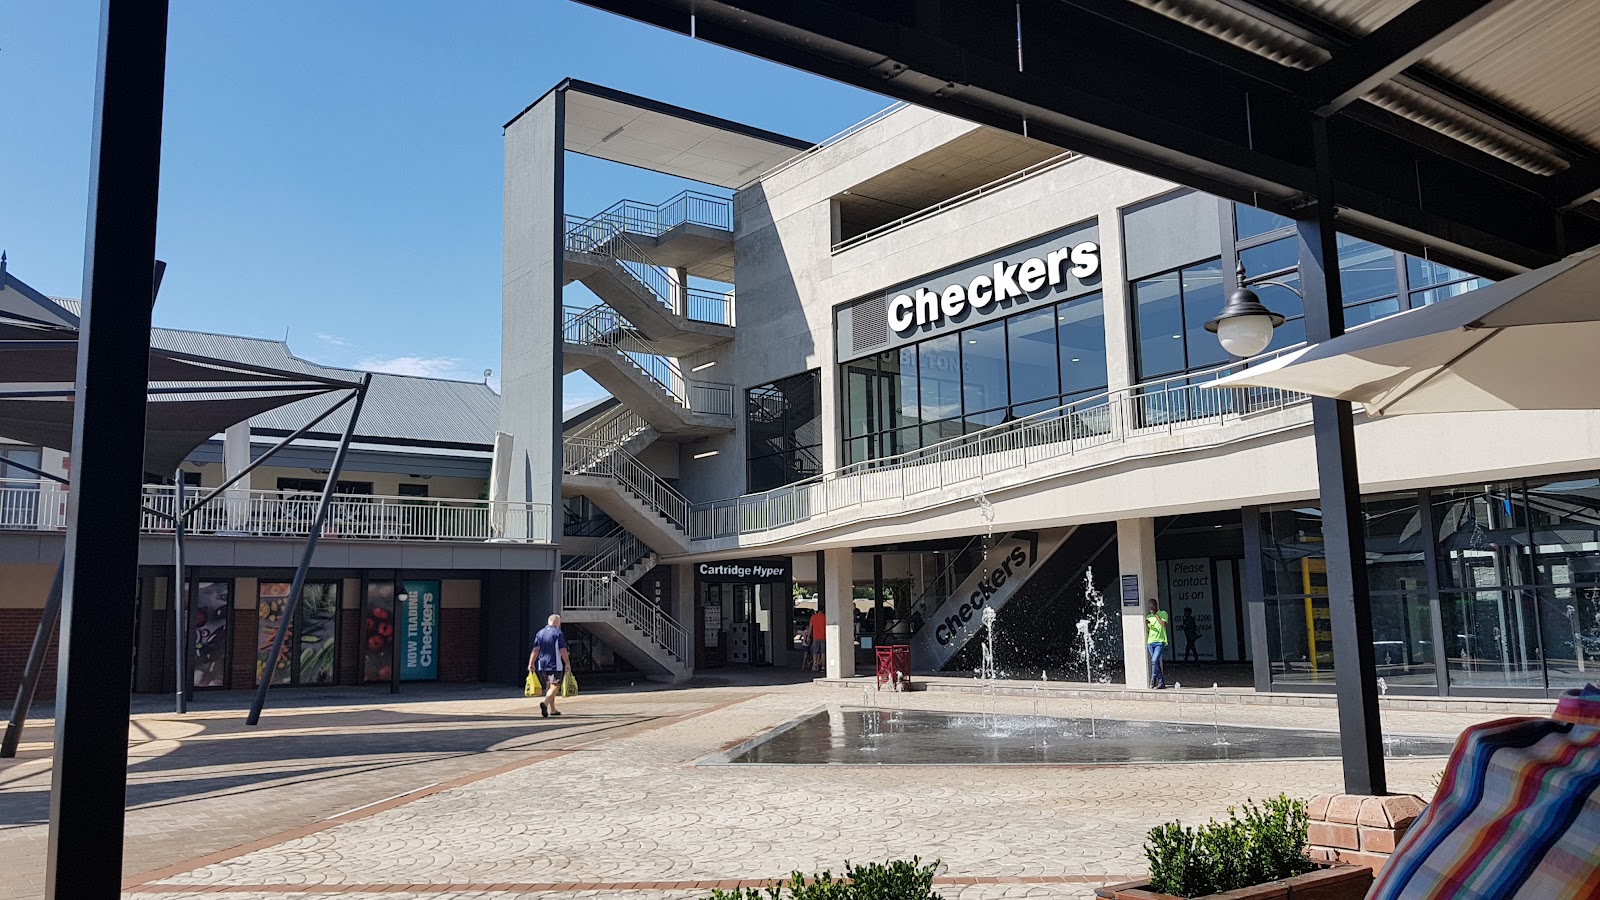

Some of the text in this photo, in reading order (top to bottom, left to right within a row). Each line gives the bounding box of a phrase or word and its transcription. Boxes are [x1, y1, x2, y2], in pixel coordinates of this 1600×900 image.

[888, 241, 1100, 332] Checkers
[700, 563, 784, 577] Cartridge Hyper
[1172, 576, 1209, 587] contact
[1174, 563, 1205, 573] Please
[935, 546, 1027, 646] Checkers
[1179, 591, 1204, 600] us on
[407, 590, 419, 668] NOW TRADING
[420, 592, 433, 667] Checkers
